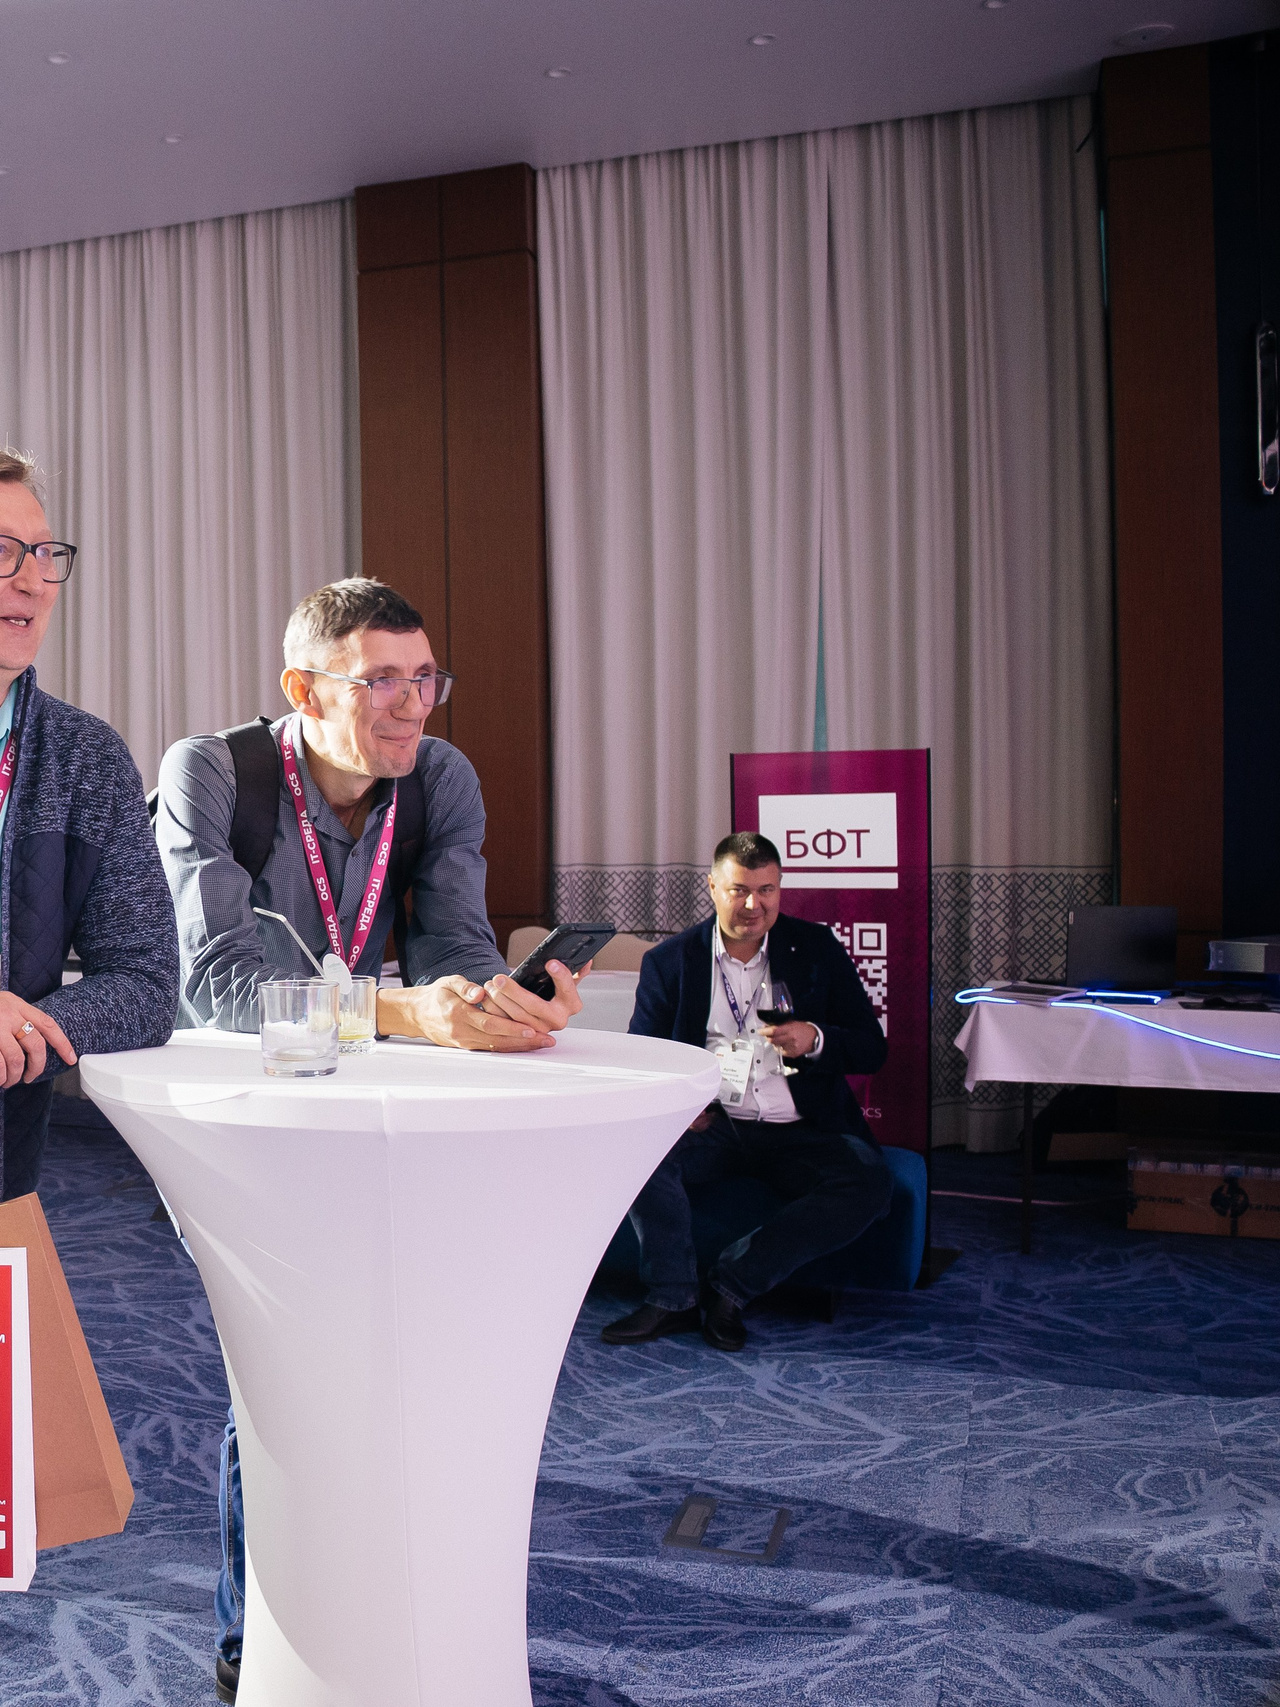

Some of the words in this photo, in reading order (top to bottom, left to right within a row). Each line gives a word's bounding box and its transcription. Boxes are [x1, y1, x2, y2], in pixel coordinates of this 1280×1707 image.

[289, 772, 302, 797] OCS
[377, 841, 389, 866] OCS
[785, 828, 871, 860] БФТ
[316, 876, 329, 901] OCS
[358, 878, 381, 932] IT-СРЕДА
[348, 945, 360, 968] OCS
